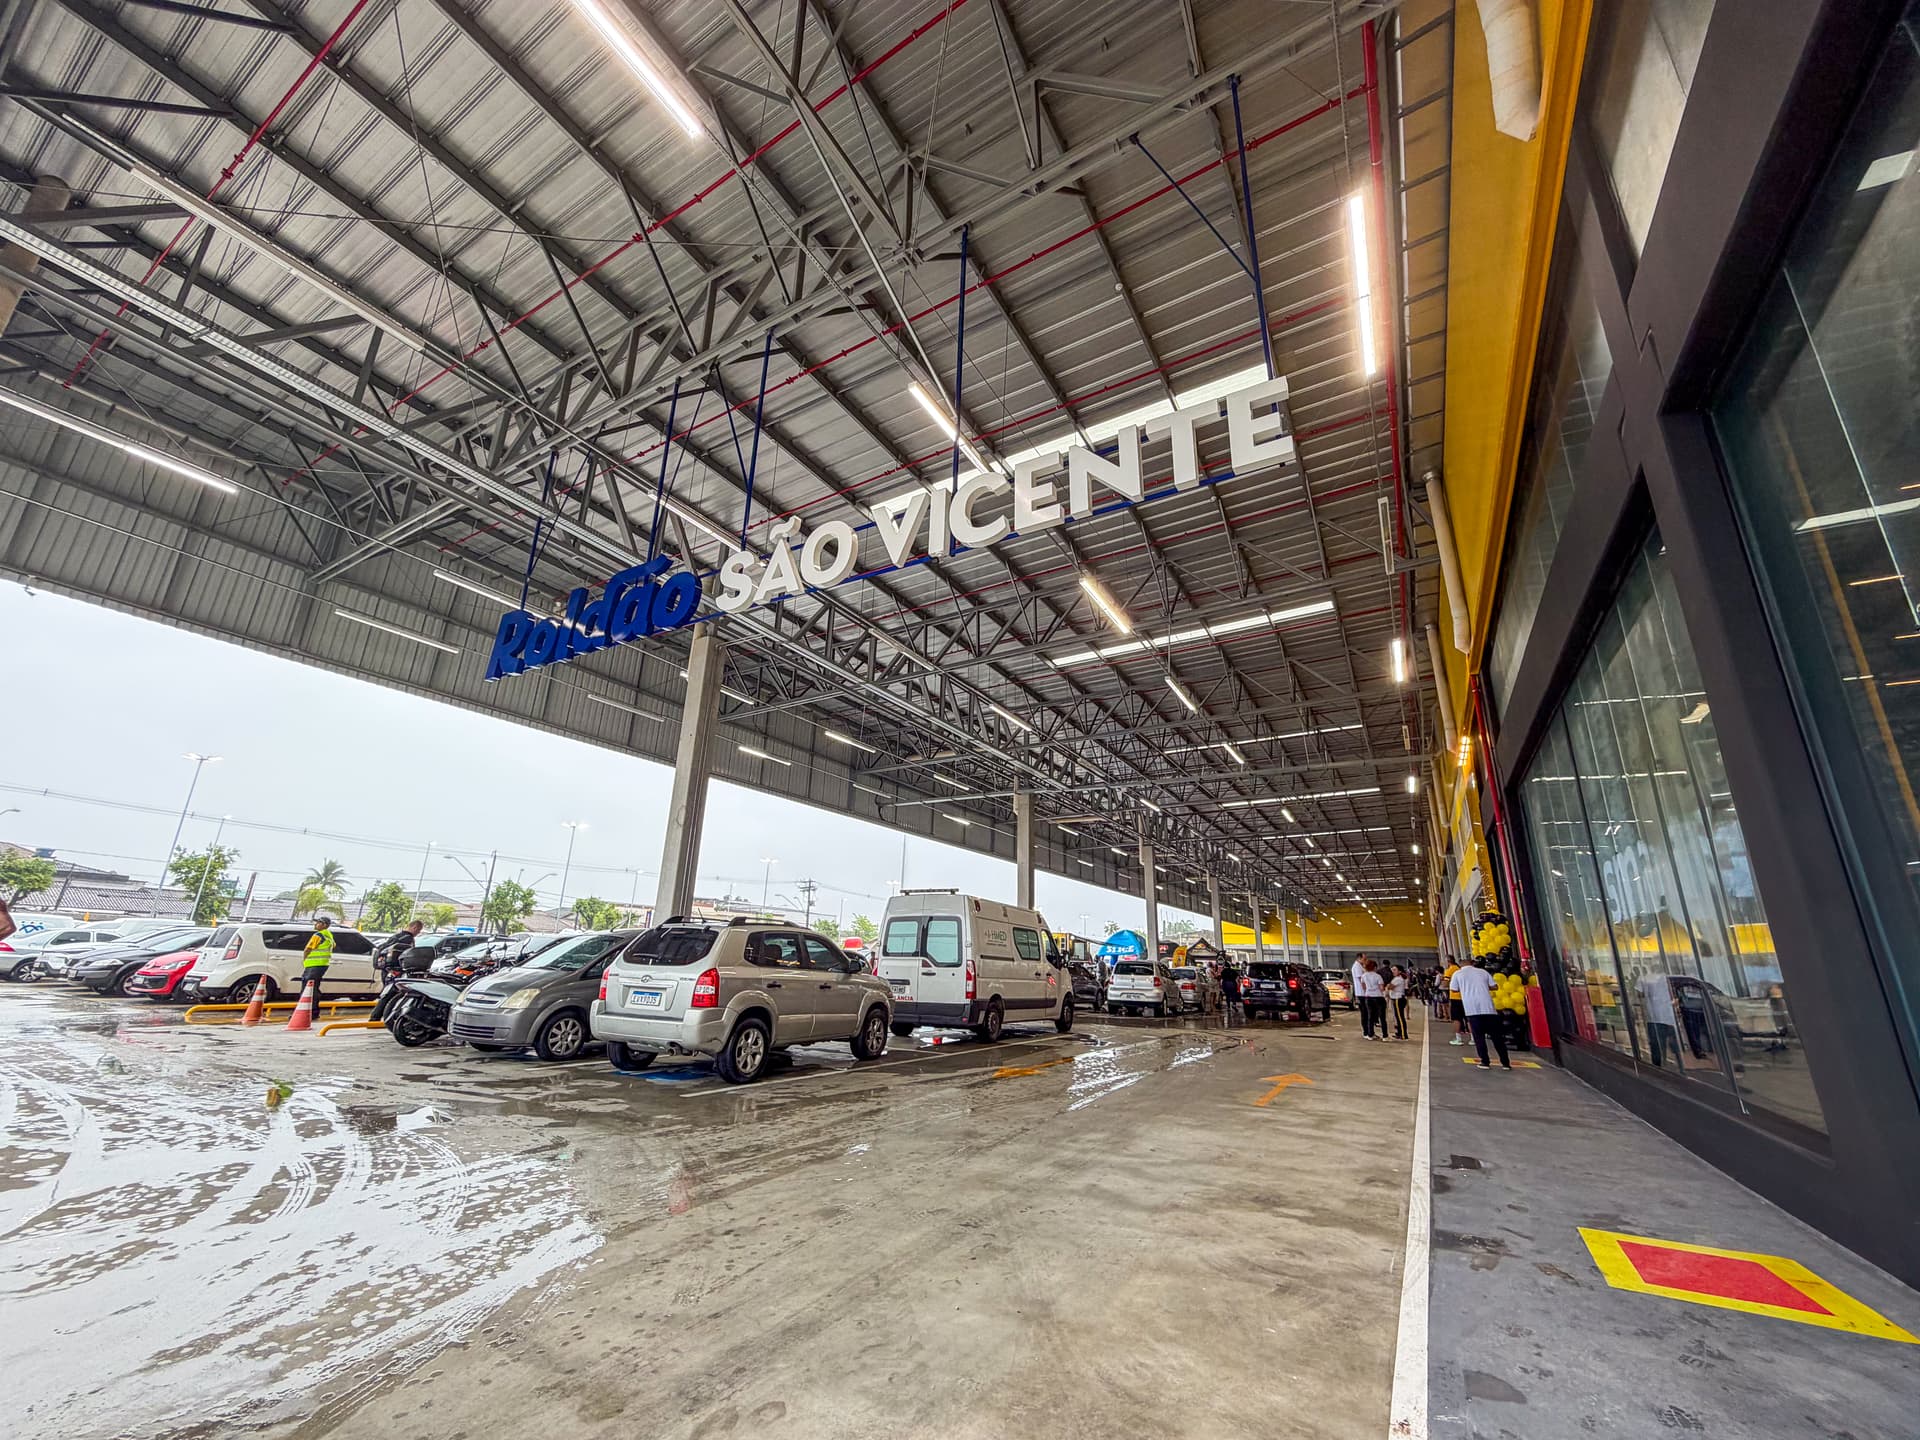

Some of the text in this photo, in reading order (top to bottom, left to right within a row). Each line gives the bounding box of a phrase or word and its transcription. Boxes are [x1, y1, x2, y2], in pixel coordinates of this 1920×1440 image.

[485, 376, 1297, 682] Roldão SÃO VICENTE
